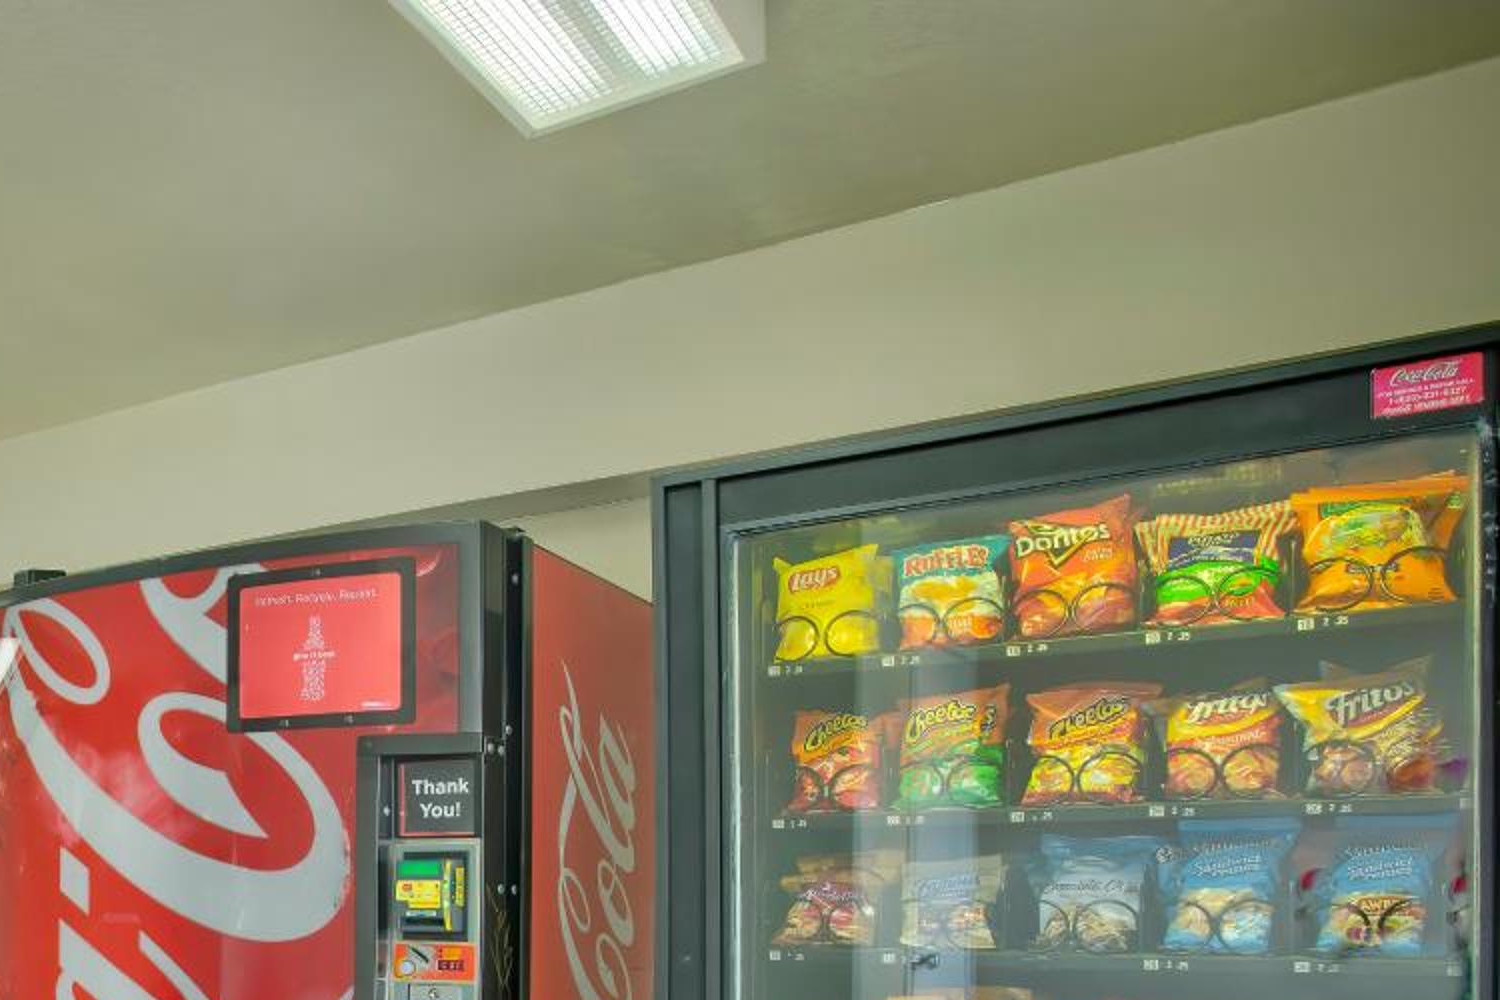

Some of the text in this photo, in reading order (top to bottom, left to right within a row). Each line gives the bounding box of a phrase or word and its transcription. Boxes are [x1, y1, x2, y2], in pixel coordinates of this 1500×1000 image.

[1016, 524, 1111, 558] Doritos
[1326, 680, 1414, 727] Fritos
[412, 778, 469, 796] Thank
[420, 802, 461, 819] You!
